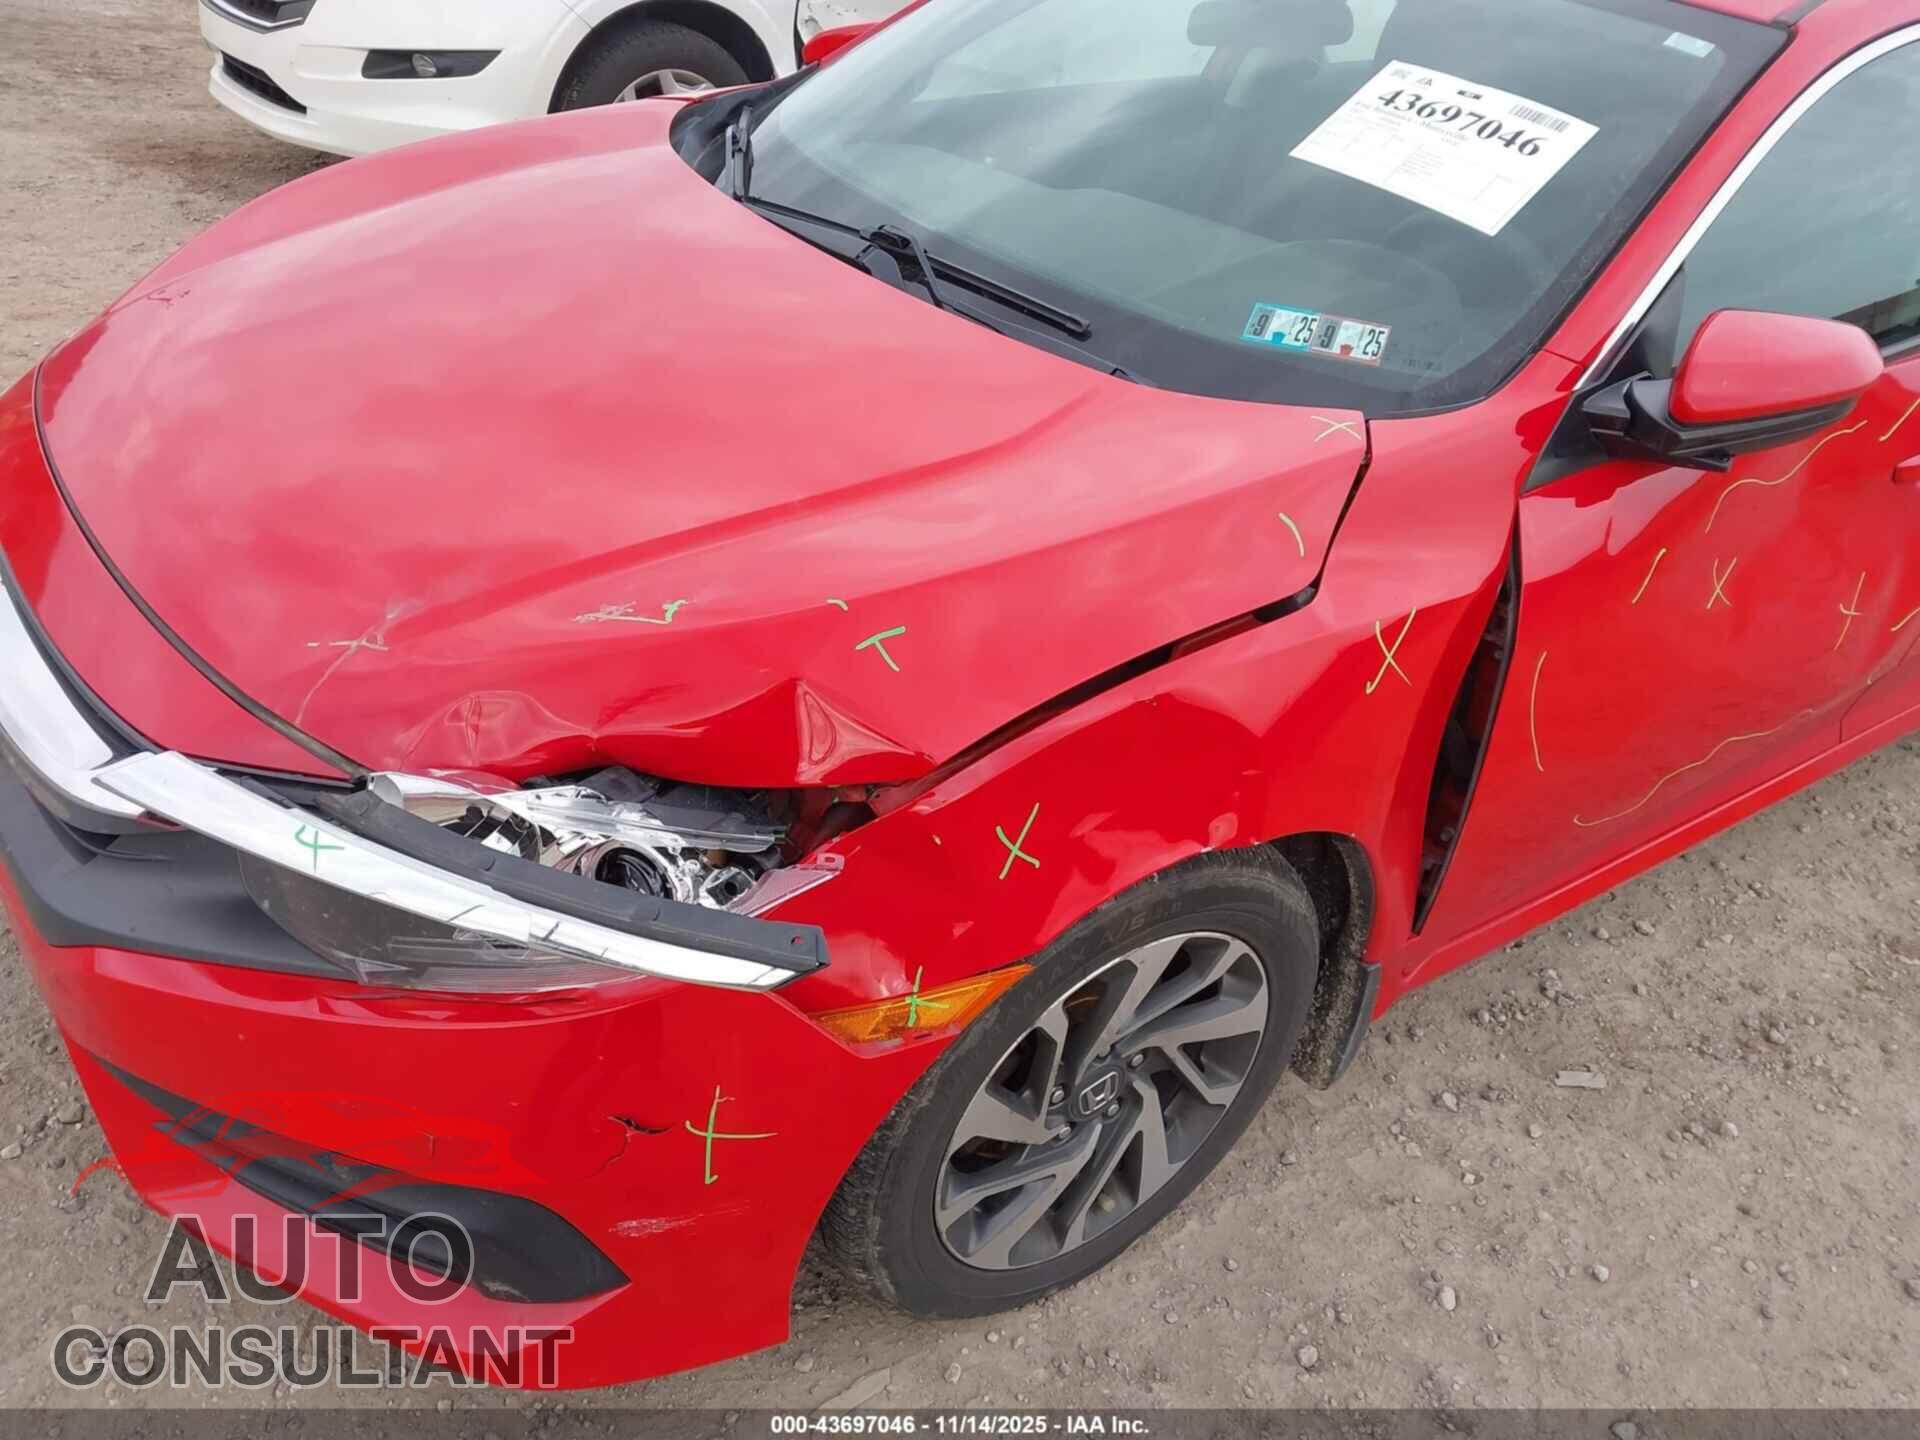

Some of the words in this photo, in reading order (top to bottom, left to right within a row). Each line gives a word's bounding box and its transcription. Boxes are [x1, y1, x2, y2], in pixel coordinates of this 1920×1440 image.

[1377, 88, 1548, 157] 43697046
[1294, 316, 1317, 344] 25
[1362, 329, 1385, 358] 25
